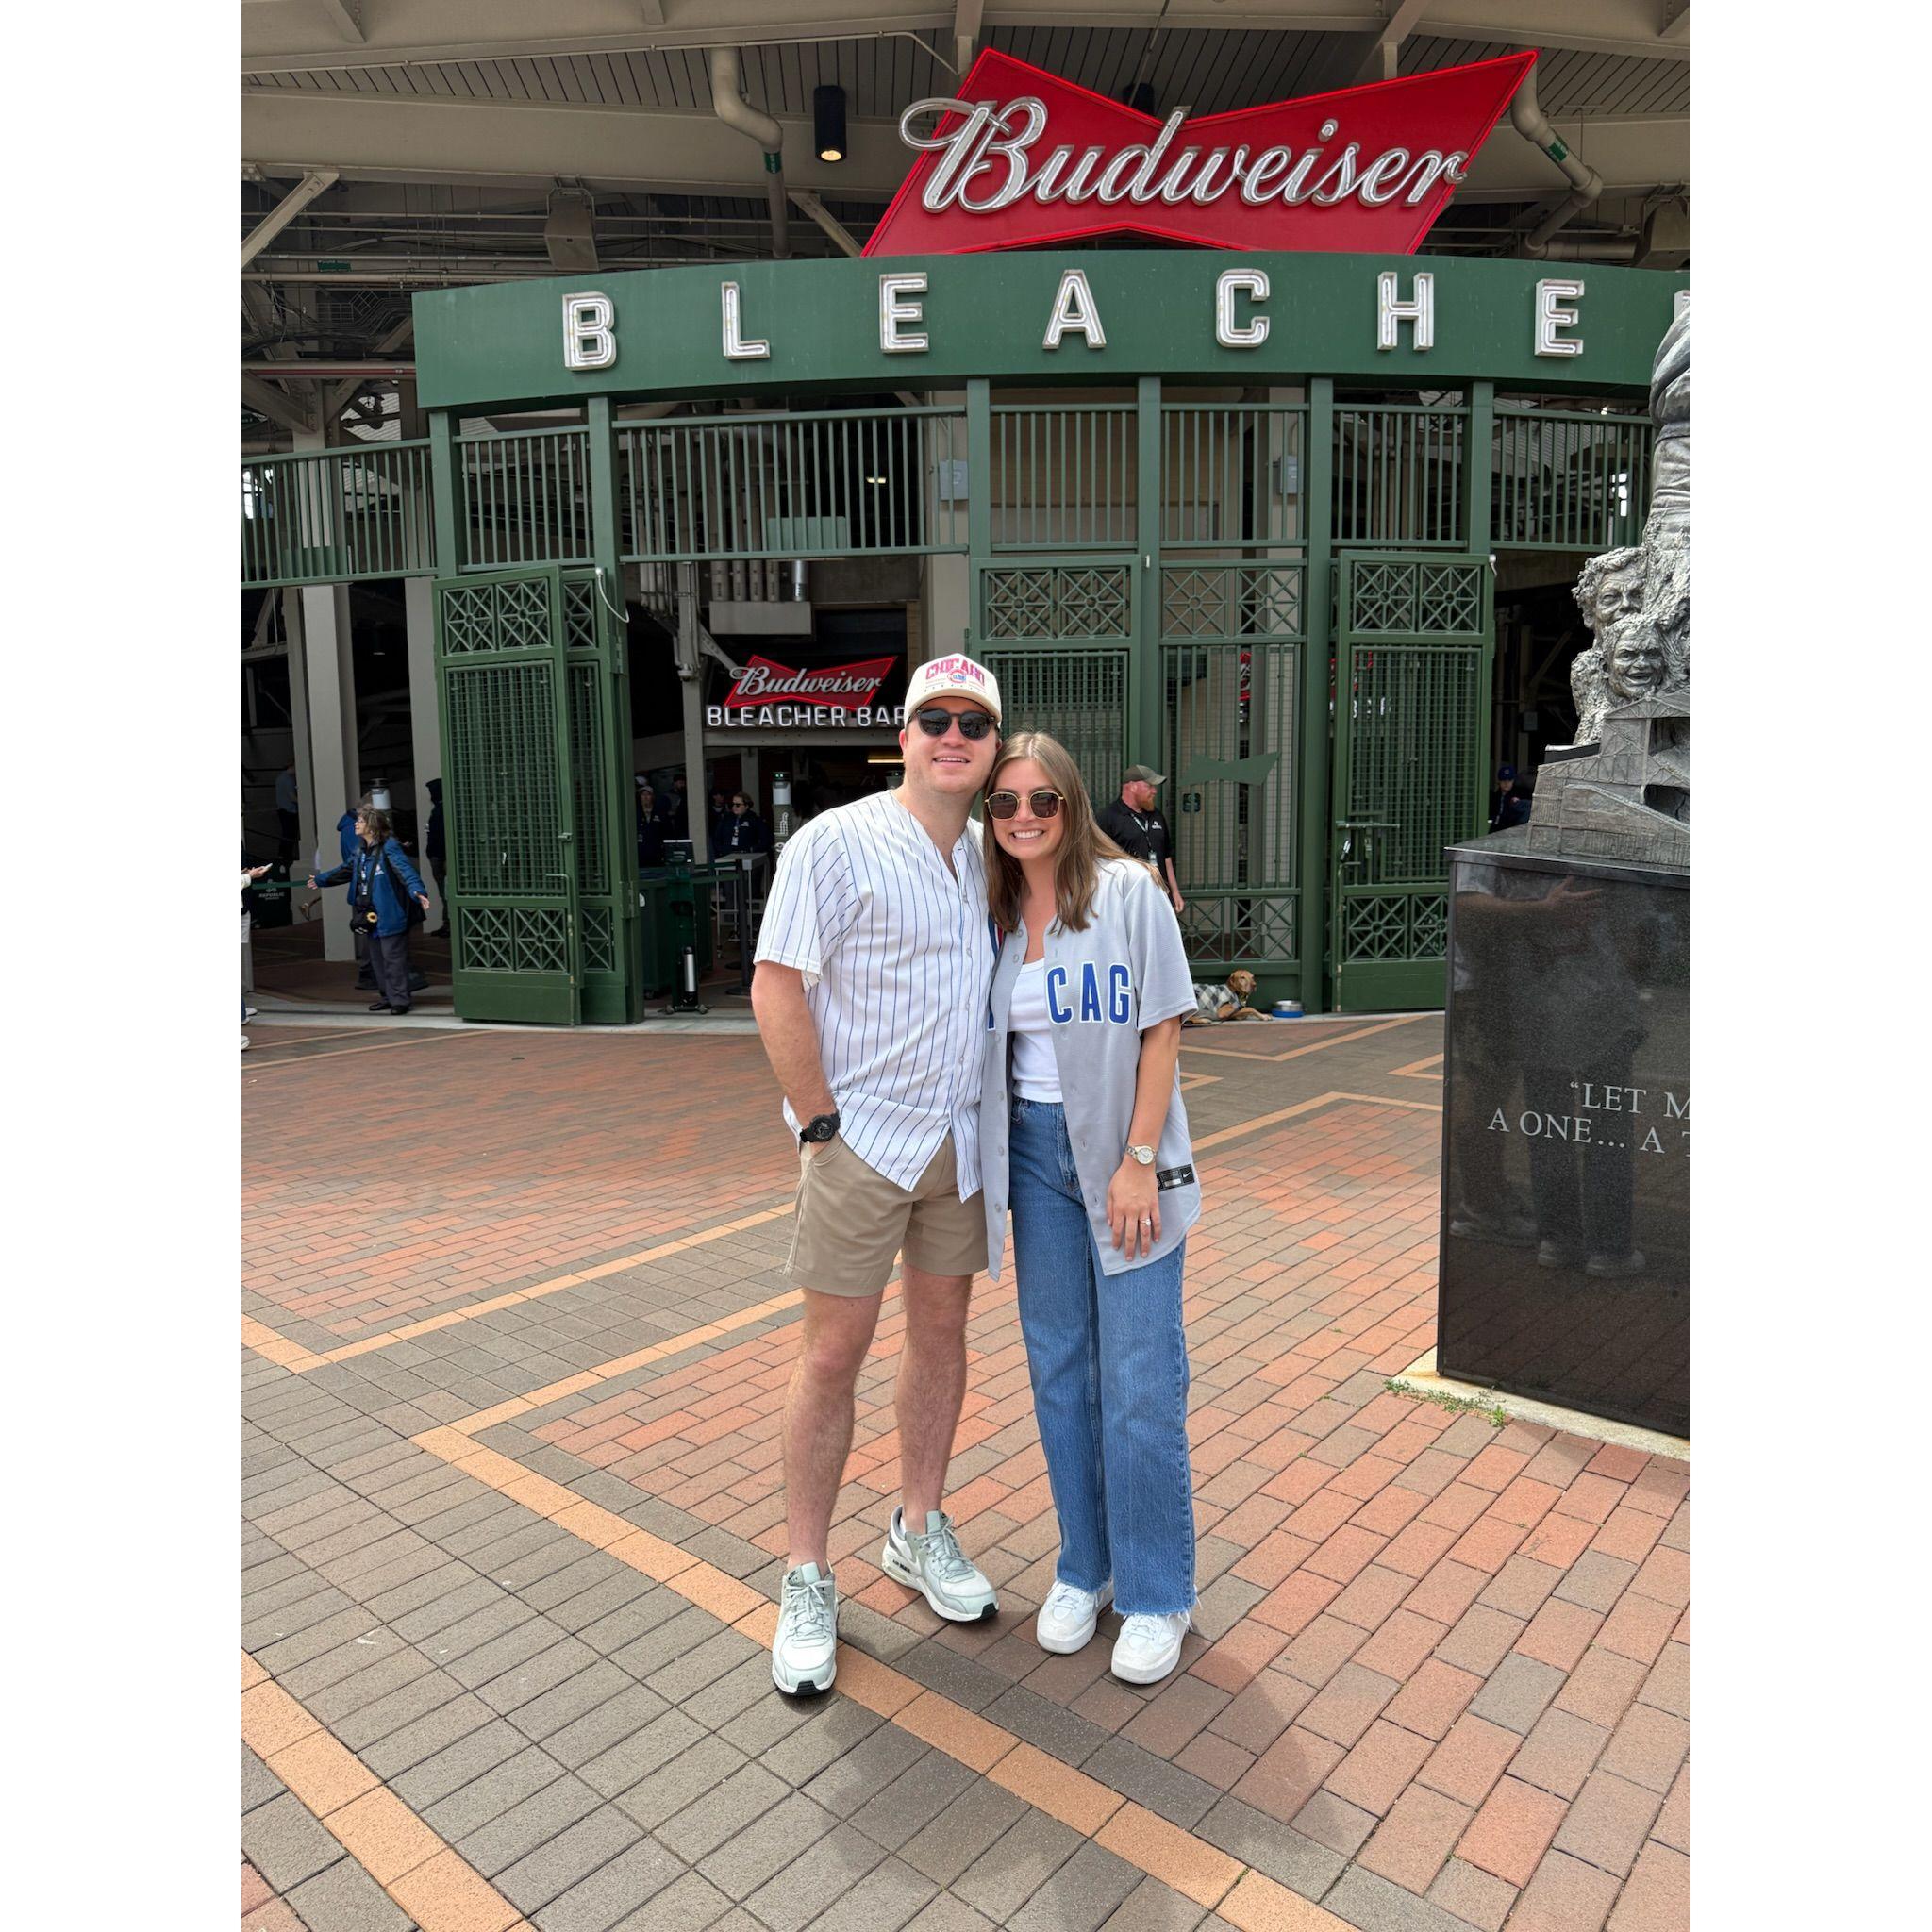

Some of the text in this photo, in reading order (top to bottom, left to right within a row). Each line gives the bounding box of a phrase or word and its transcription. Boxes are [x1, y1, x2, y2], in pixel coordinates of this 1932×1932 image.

[899, 97, 1468, 214] Budweiser
[562, 268, 1690, 370] BLEACHE
[729, 666, 882, 696] Budweiser
[708, 706, 846, 727] BLEACHER
[1045, 960, 1132, 1025] CAG
[1487, 1107, 1509, 1133] A
[1639, 1126, 1665, 1154] A
